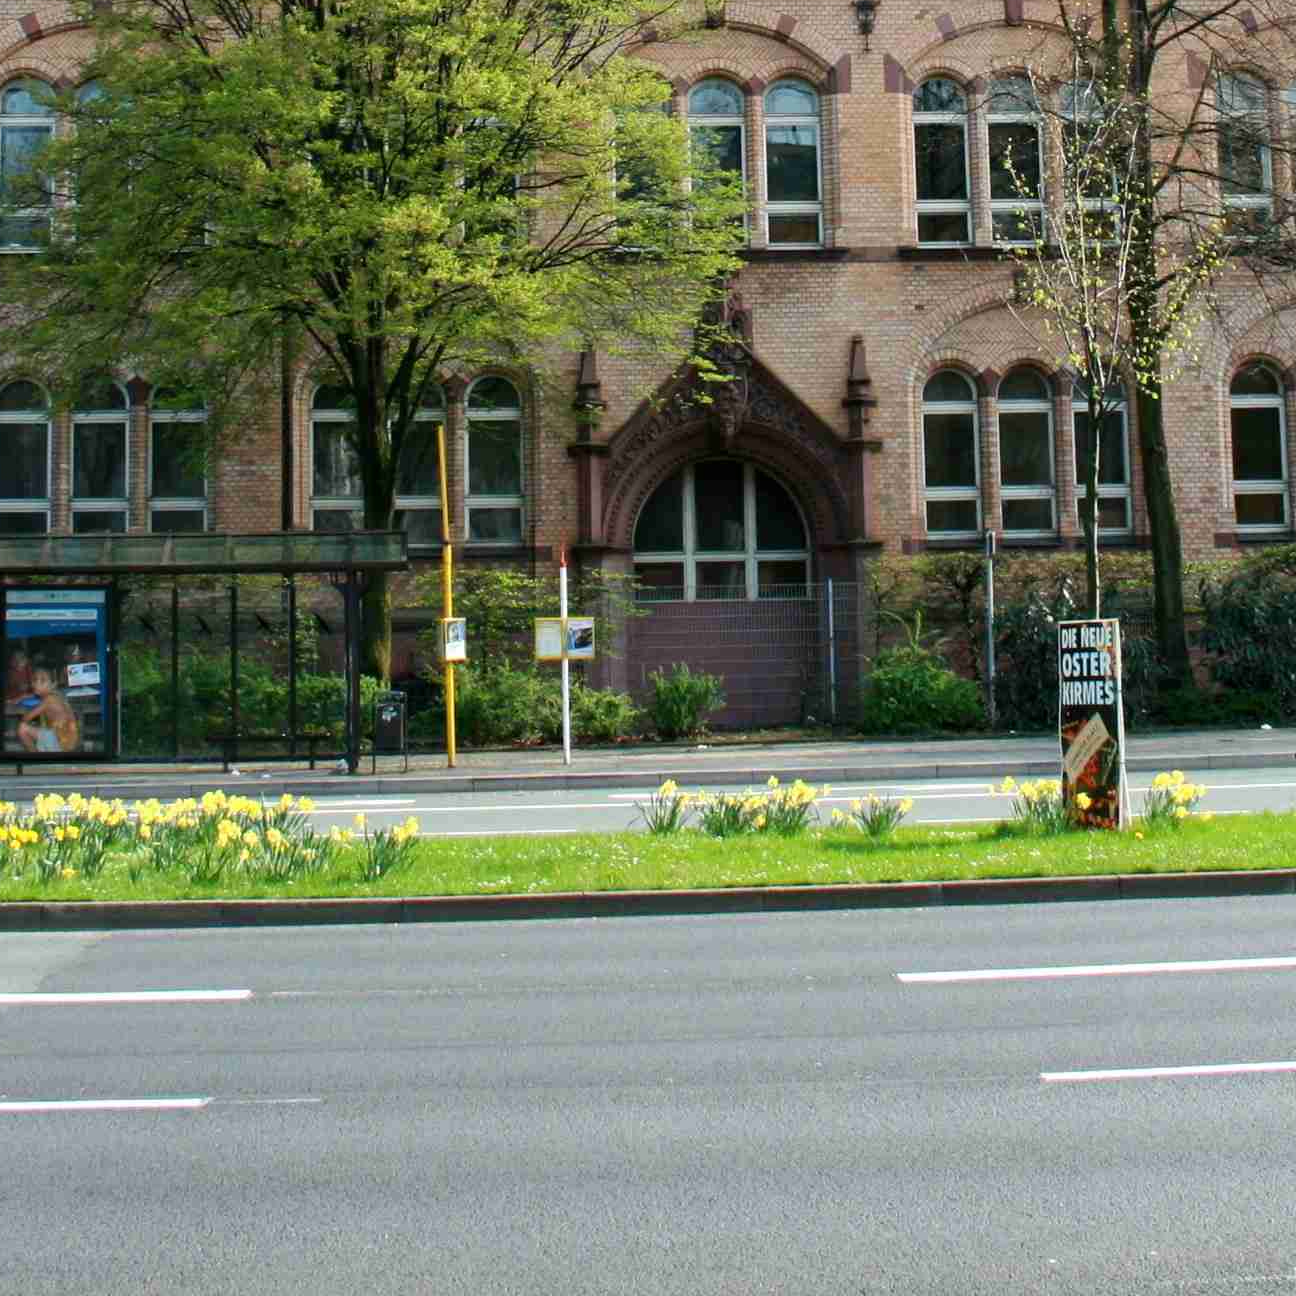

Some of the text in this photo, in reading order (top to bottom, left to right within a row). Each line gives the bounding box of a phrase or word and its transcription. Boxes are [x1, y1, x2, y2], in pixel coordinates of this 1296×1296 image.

[1061, 626, 1113, 649] DIE NEUE
[1062, 680, 1115, 706] KIRMES
